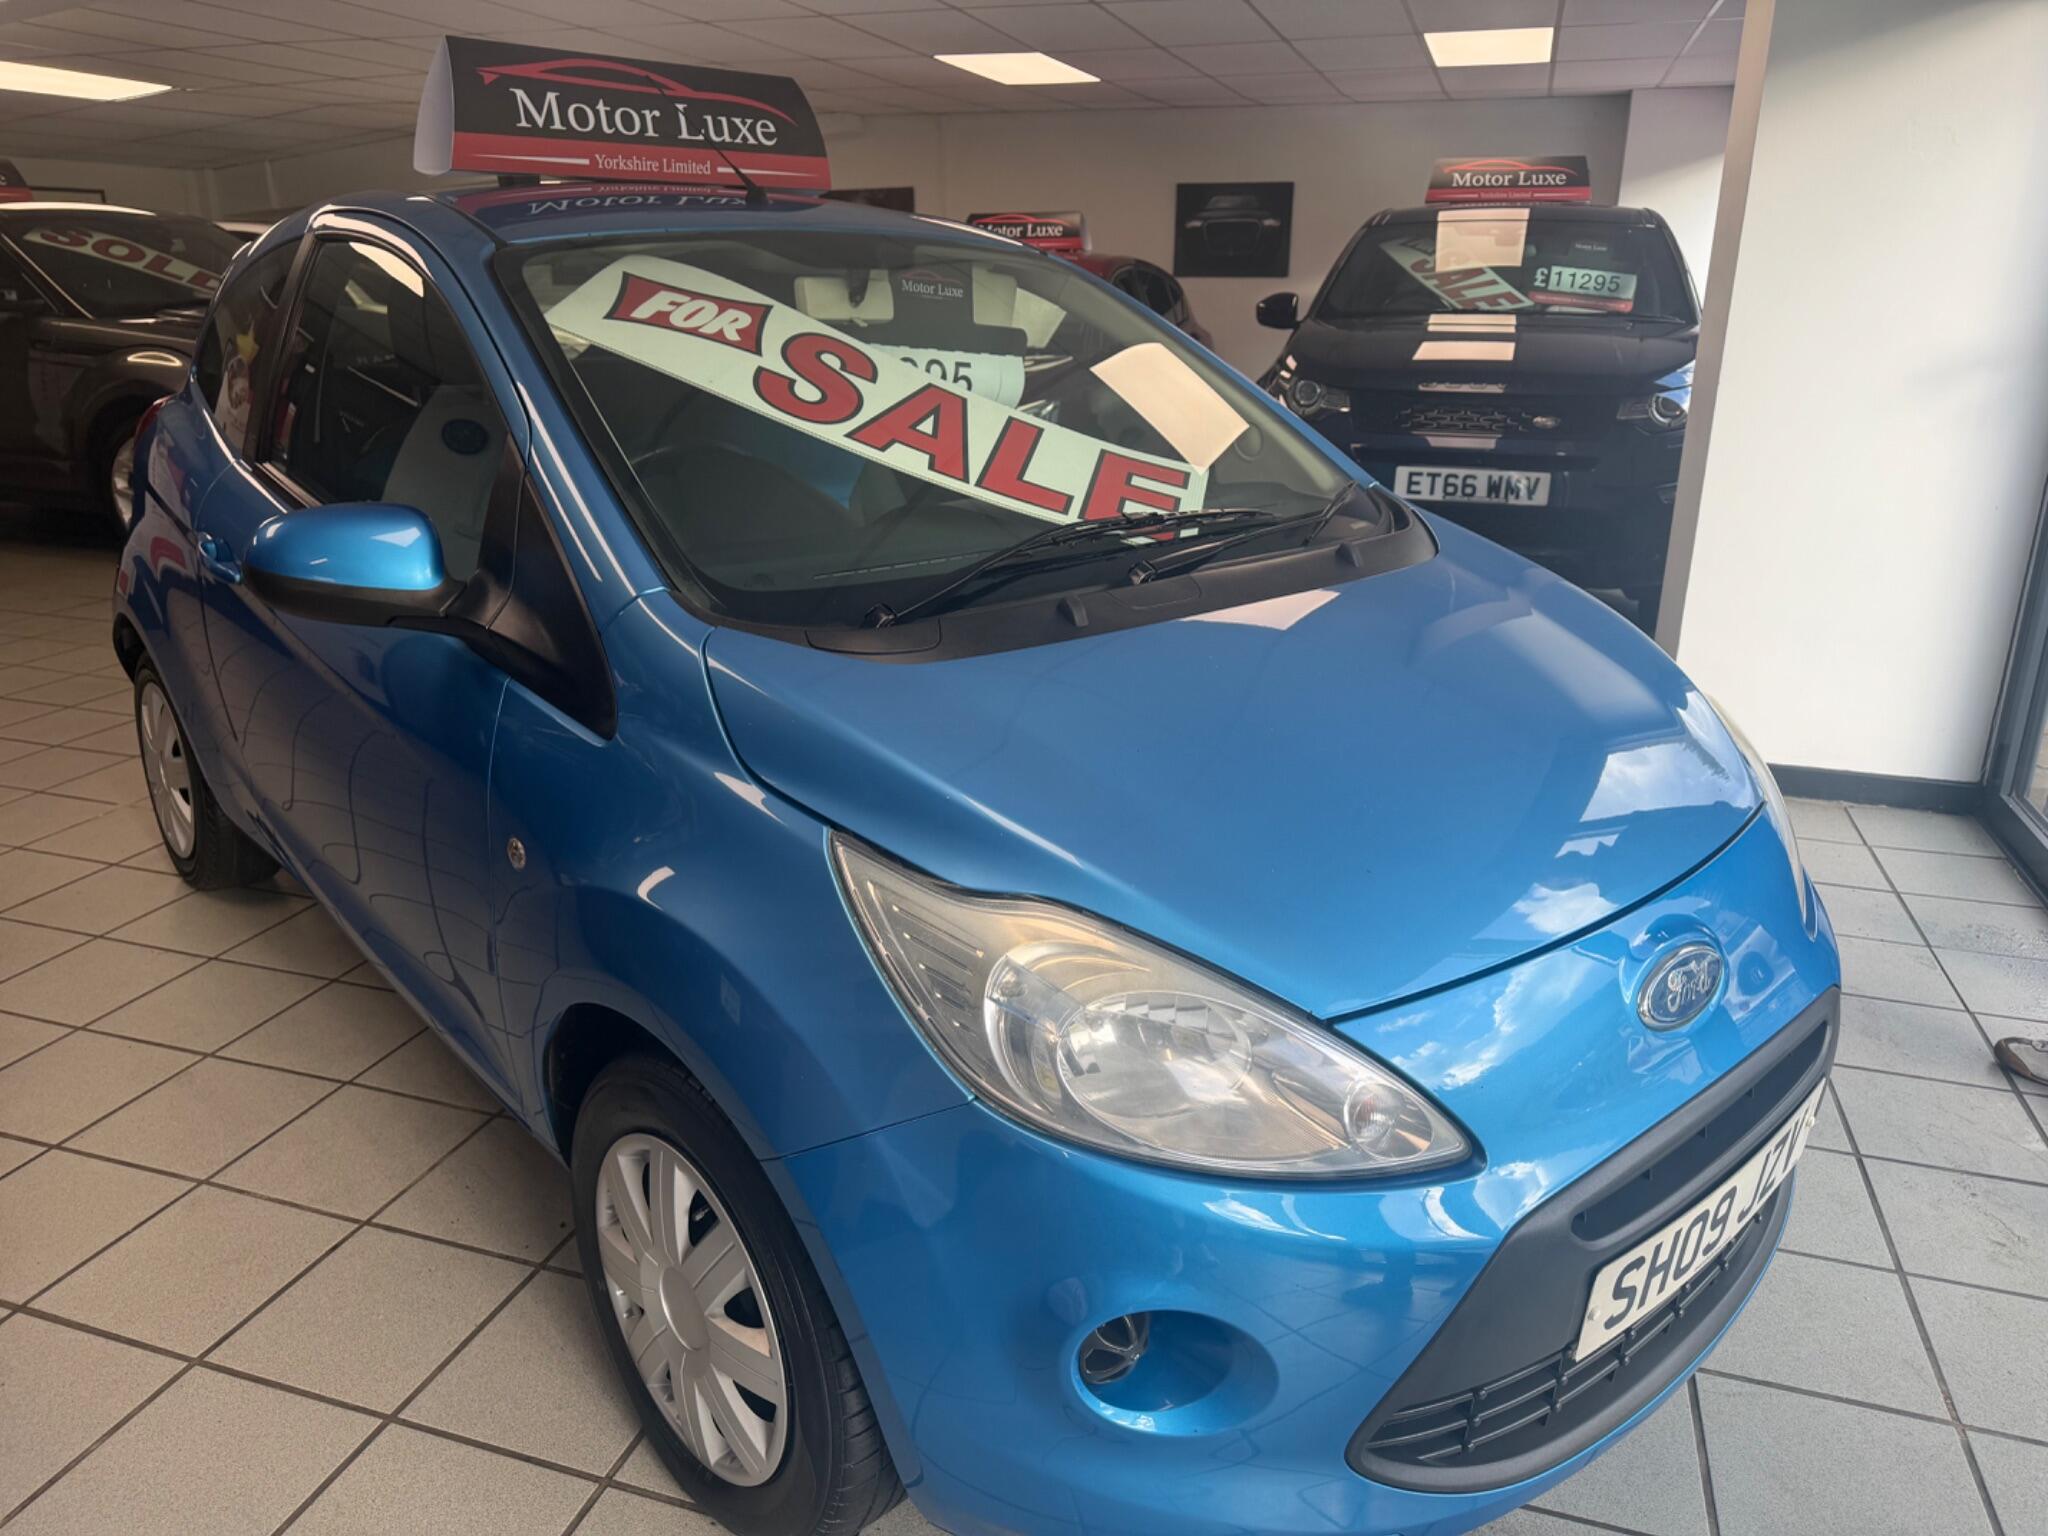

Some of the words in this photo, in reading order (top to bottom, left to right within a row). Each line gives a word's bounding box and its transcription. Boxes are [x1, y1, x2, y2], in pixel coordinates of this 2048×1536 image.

[509, 87, 661, 138] Motor
[675, 103, 778, 147] Luxe
[594, 153, 660, 173] Yorkshire
[662, 158, 711, 176] Limited
[1452, 171, 1513, 187] Motor
[1517, 171, 1567, 186] Luxe
[1026, 223, 1064, 237] Luxe
[902, 279, 935, 295] Motor
[938, 283, 964, 298] Luxe
[630, 290, 752, 342] FOR
[752, 332, 1192, 544] SALE
[1406, 472, 1478, 498] ET66
[1667, 955, 1712, 1012] Ford
[1604, 1184, 1738, 1331] SH09
